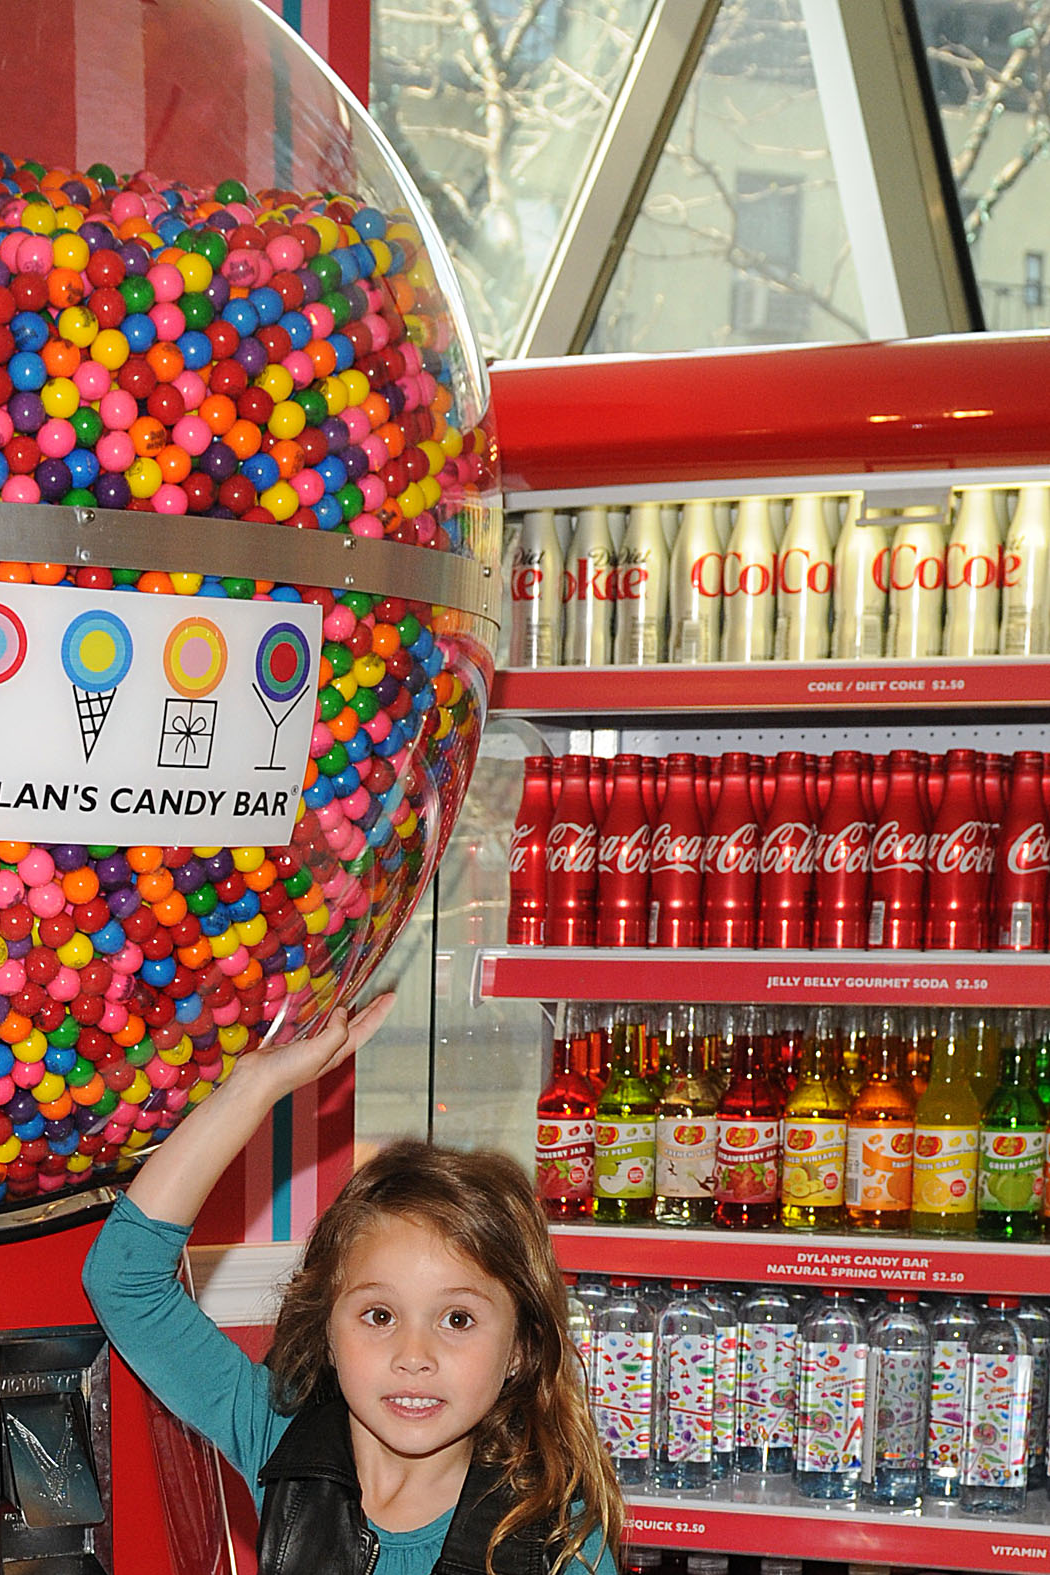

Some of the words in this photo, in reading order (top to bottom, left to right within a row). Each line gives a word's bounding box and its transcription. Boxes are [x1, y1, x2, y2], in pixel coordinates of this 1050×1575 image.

[807, 681, 843, 692] COKE
[855, 680, 887, 691] DIET
[889, 680, 926, 691] COKE
[932, 679, 965, 691] $2.50
[110, 787, 231, 817] CANDY
[766, 976, 801, 988] JELLY
[845, 977, 910, 988] GOURMET
[913, 978, 949, 989] SODA
[955, 979, 988, 990] $2.50
[797, 1253, 851, 1265] DYLAN'S
[853, 1255, 900, 1267] CANDY
[766, 1264, 828, 1277] NATURAL
[830, 1267, 877, 1279] SPRING
[880, 1269, 926, 1281] WATER
[932, 1271, 965, 1282] $2.50
[675, 1522, 706, 1534] $2.50
[991, 1544, 1048, 1558] VITAMIN
